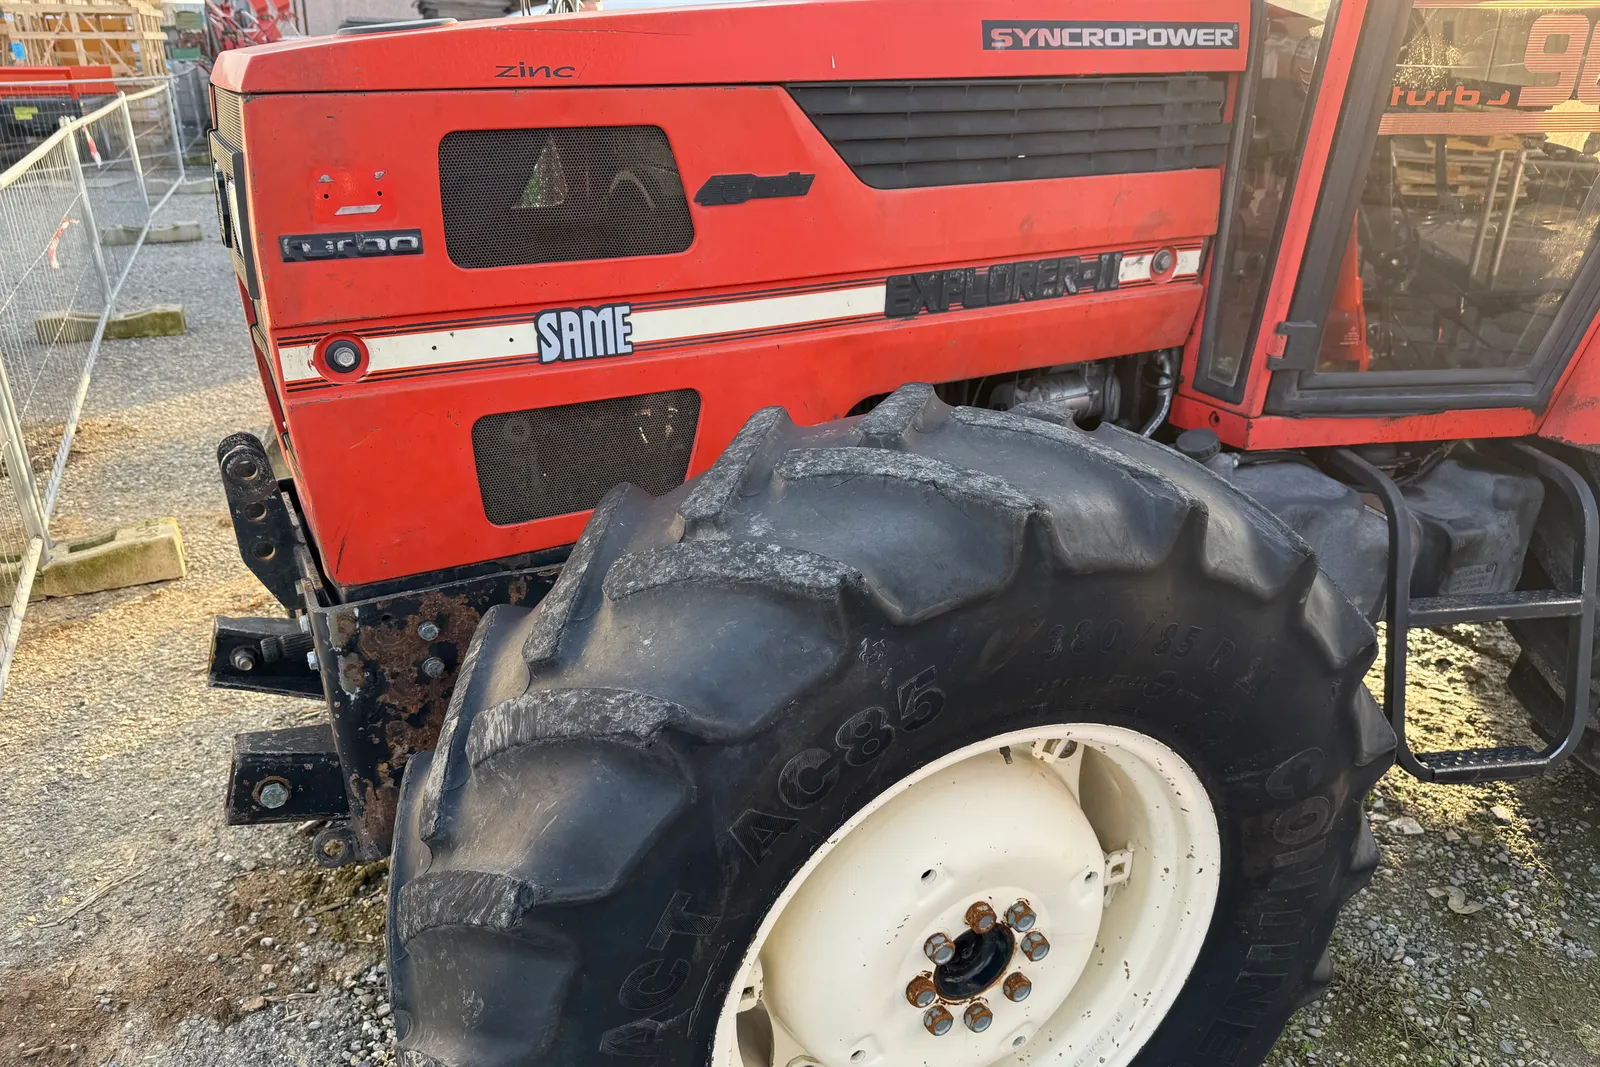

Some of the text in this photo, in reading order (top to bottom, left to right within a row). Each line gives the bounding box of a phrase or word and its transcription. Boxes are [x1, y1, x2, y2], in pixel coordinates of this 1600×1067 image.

[991, 27, 1233, 47] SYNCROPOWER
[495, 61, 576, 78] zinc
[536, 304, 633, 363] SAME
[728, 664, 946, 867] AC85
